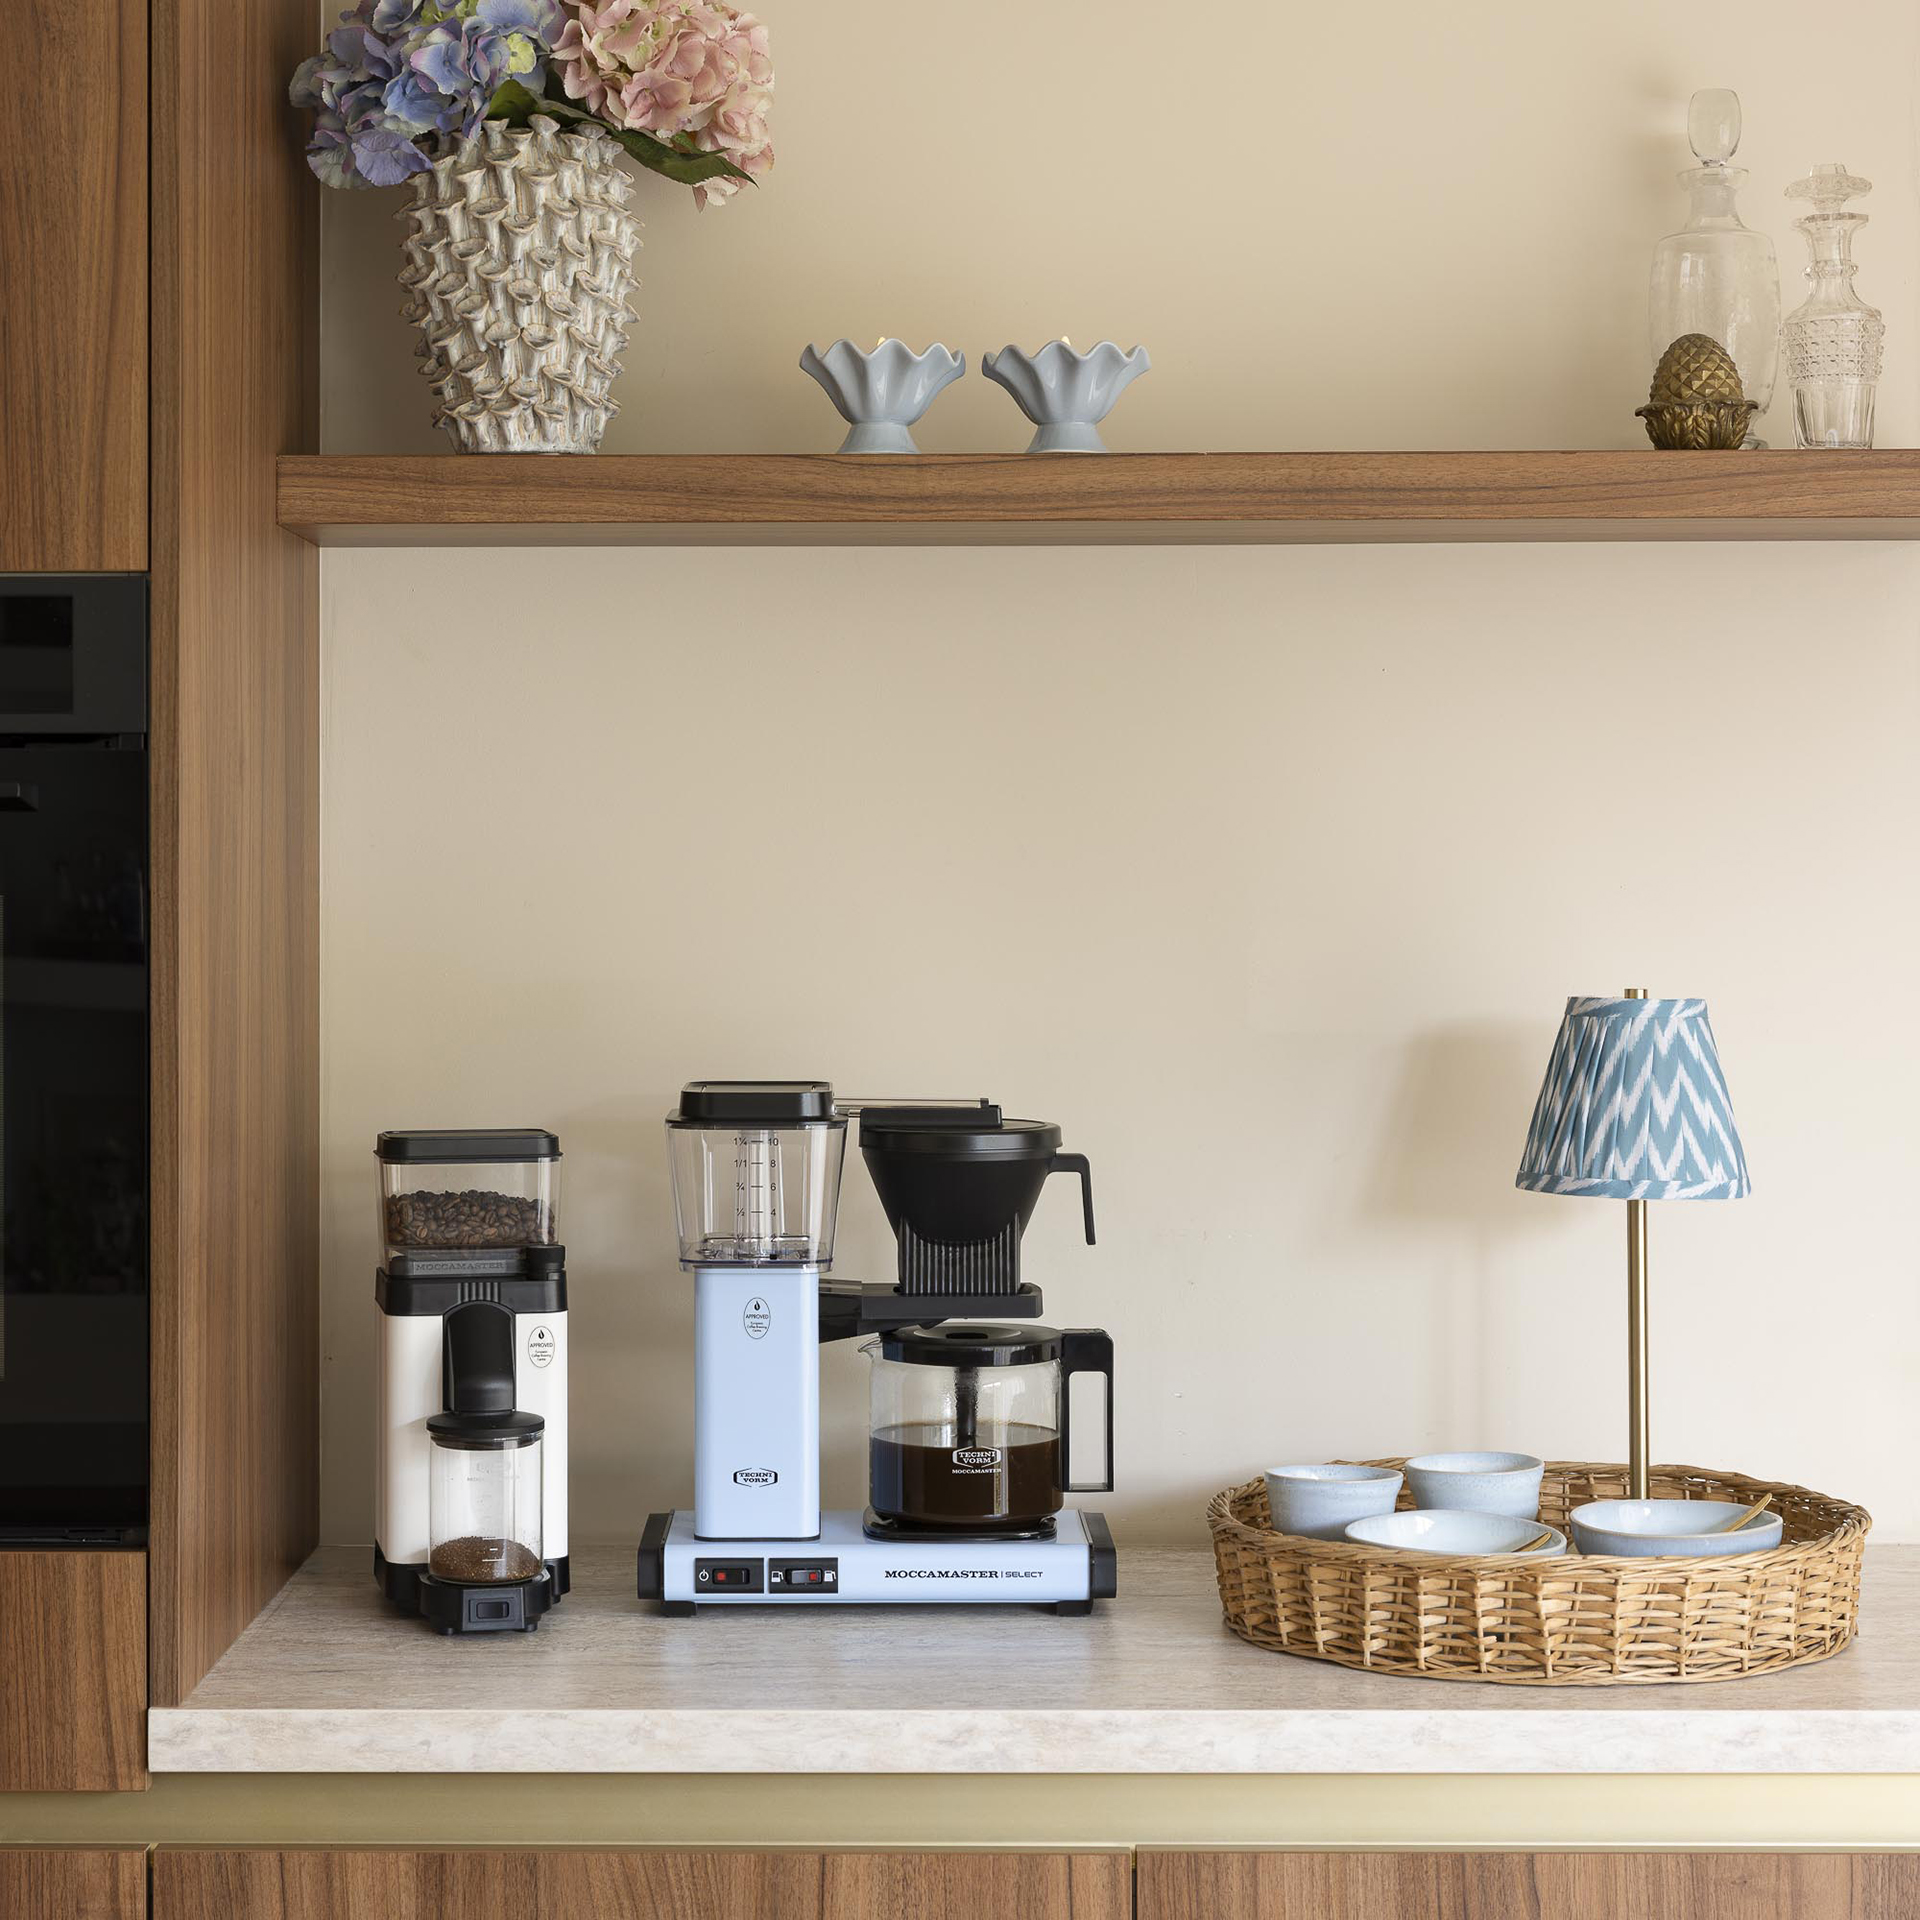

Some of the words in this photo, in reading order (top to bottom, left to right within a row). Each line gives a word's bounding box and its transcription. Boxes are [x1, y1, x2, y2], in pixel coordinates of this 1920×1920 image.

[768, 1137, 779, 1146] 10
[733, 1159, 747, 1168] 1/1
[770, 1159, 776, 1168] 8
[770, 1182, 777, 1191] 6
[770, 1208, 776, 1217] 4
[415, 1262, 505, 1271] MOCCAMASTER
[884, 1570, 999, 1579] MOCCAMASTER
